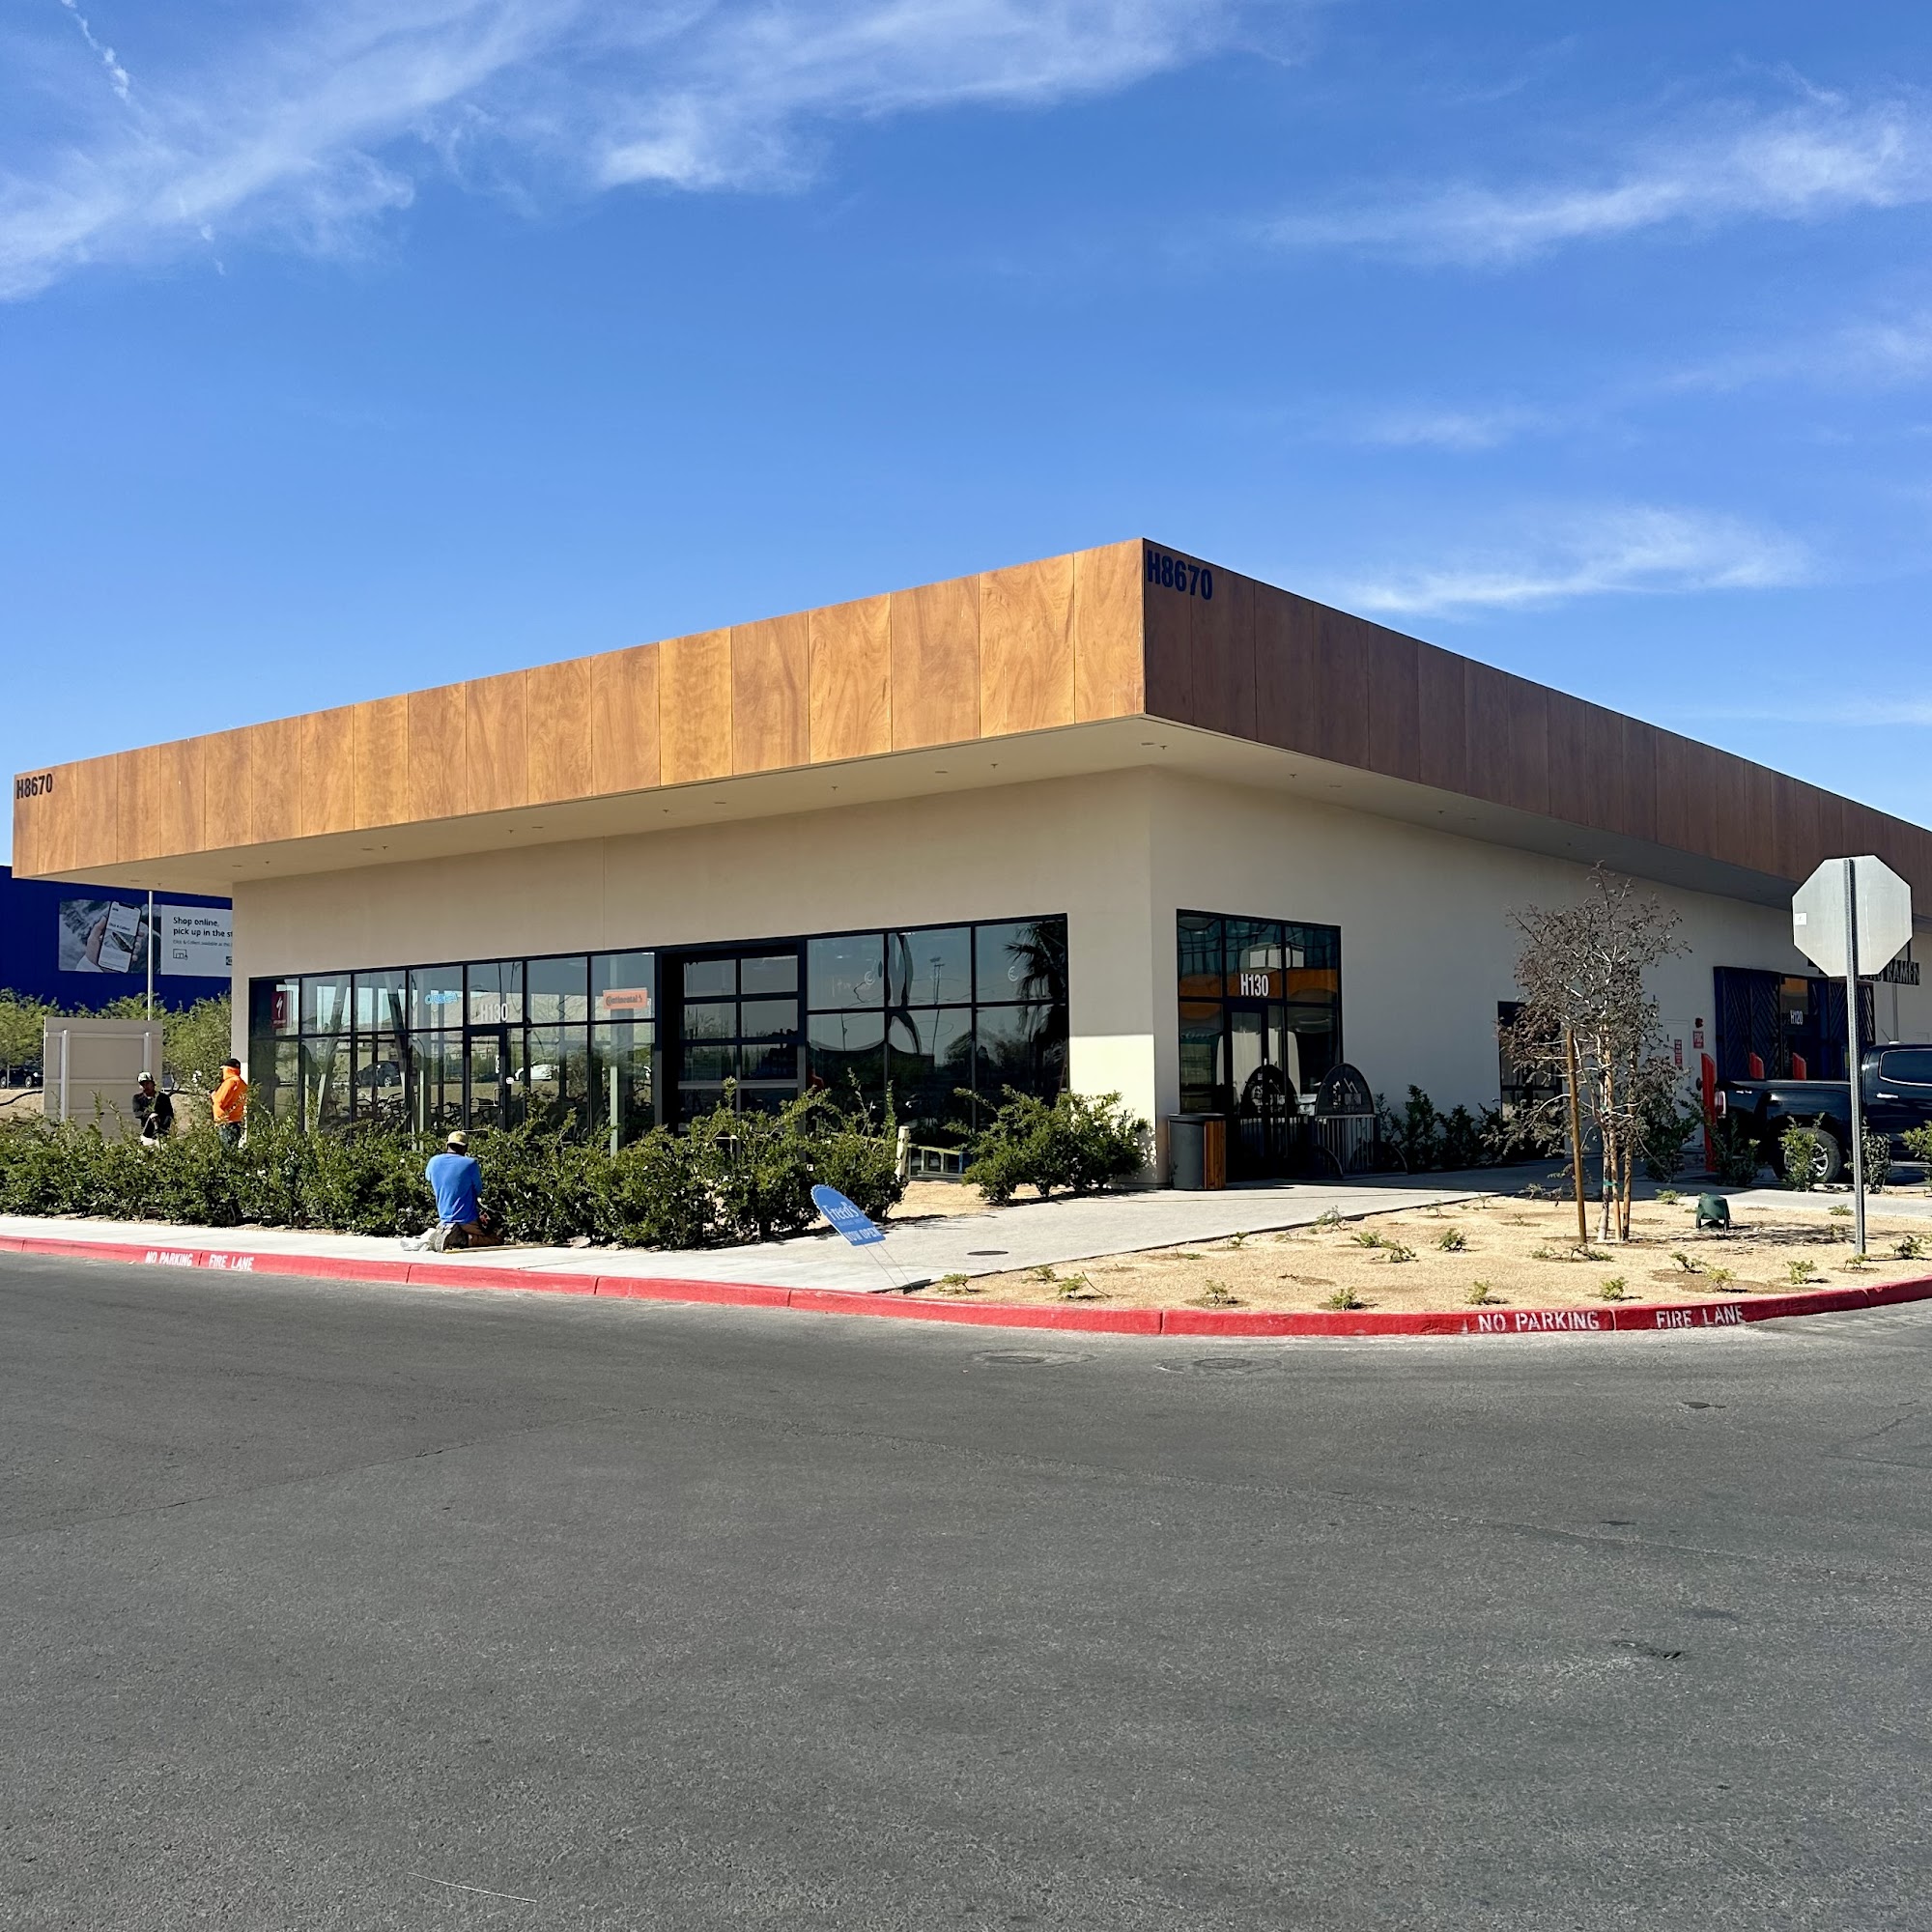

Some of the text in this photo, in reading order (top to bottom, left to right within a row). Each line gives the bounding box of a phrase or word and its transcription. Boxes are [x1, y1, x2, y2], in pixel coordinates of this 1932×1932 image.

[1147, 549, 1213, 601] H8670
[15, 773, 53, 800] H8670
[173, 917, 192, 926] Shop
[1240, 973, 1269, 997] H130
[480, 1003, 509, 1022] H130
[1789, 1009, 1804, 1026] H120
[822, 1201, 859, 1221] Freed's
[843, 1226, 882, 1242] NOW OPEN
[146, 1251, 255, 1271] NO PARKING FIRE LANE
[1477, 1305, 1747, 1332] NO PARKING FIRE LANE
